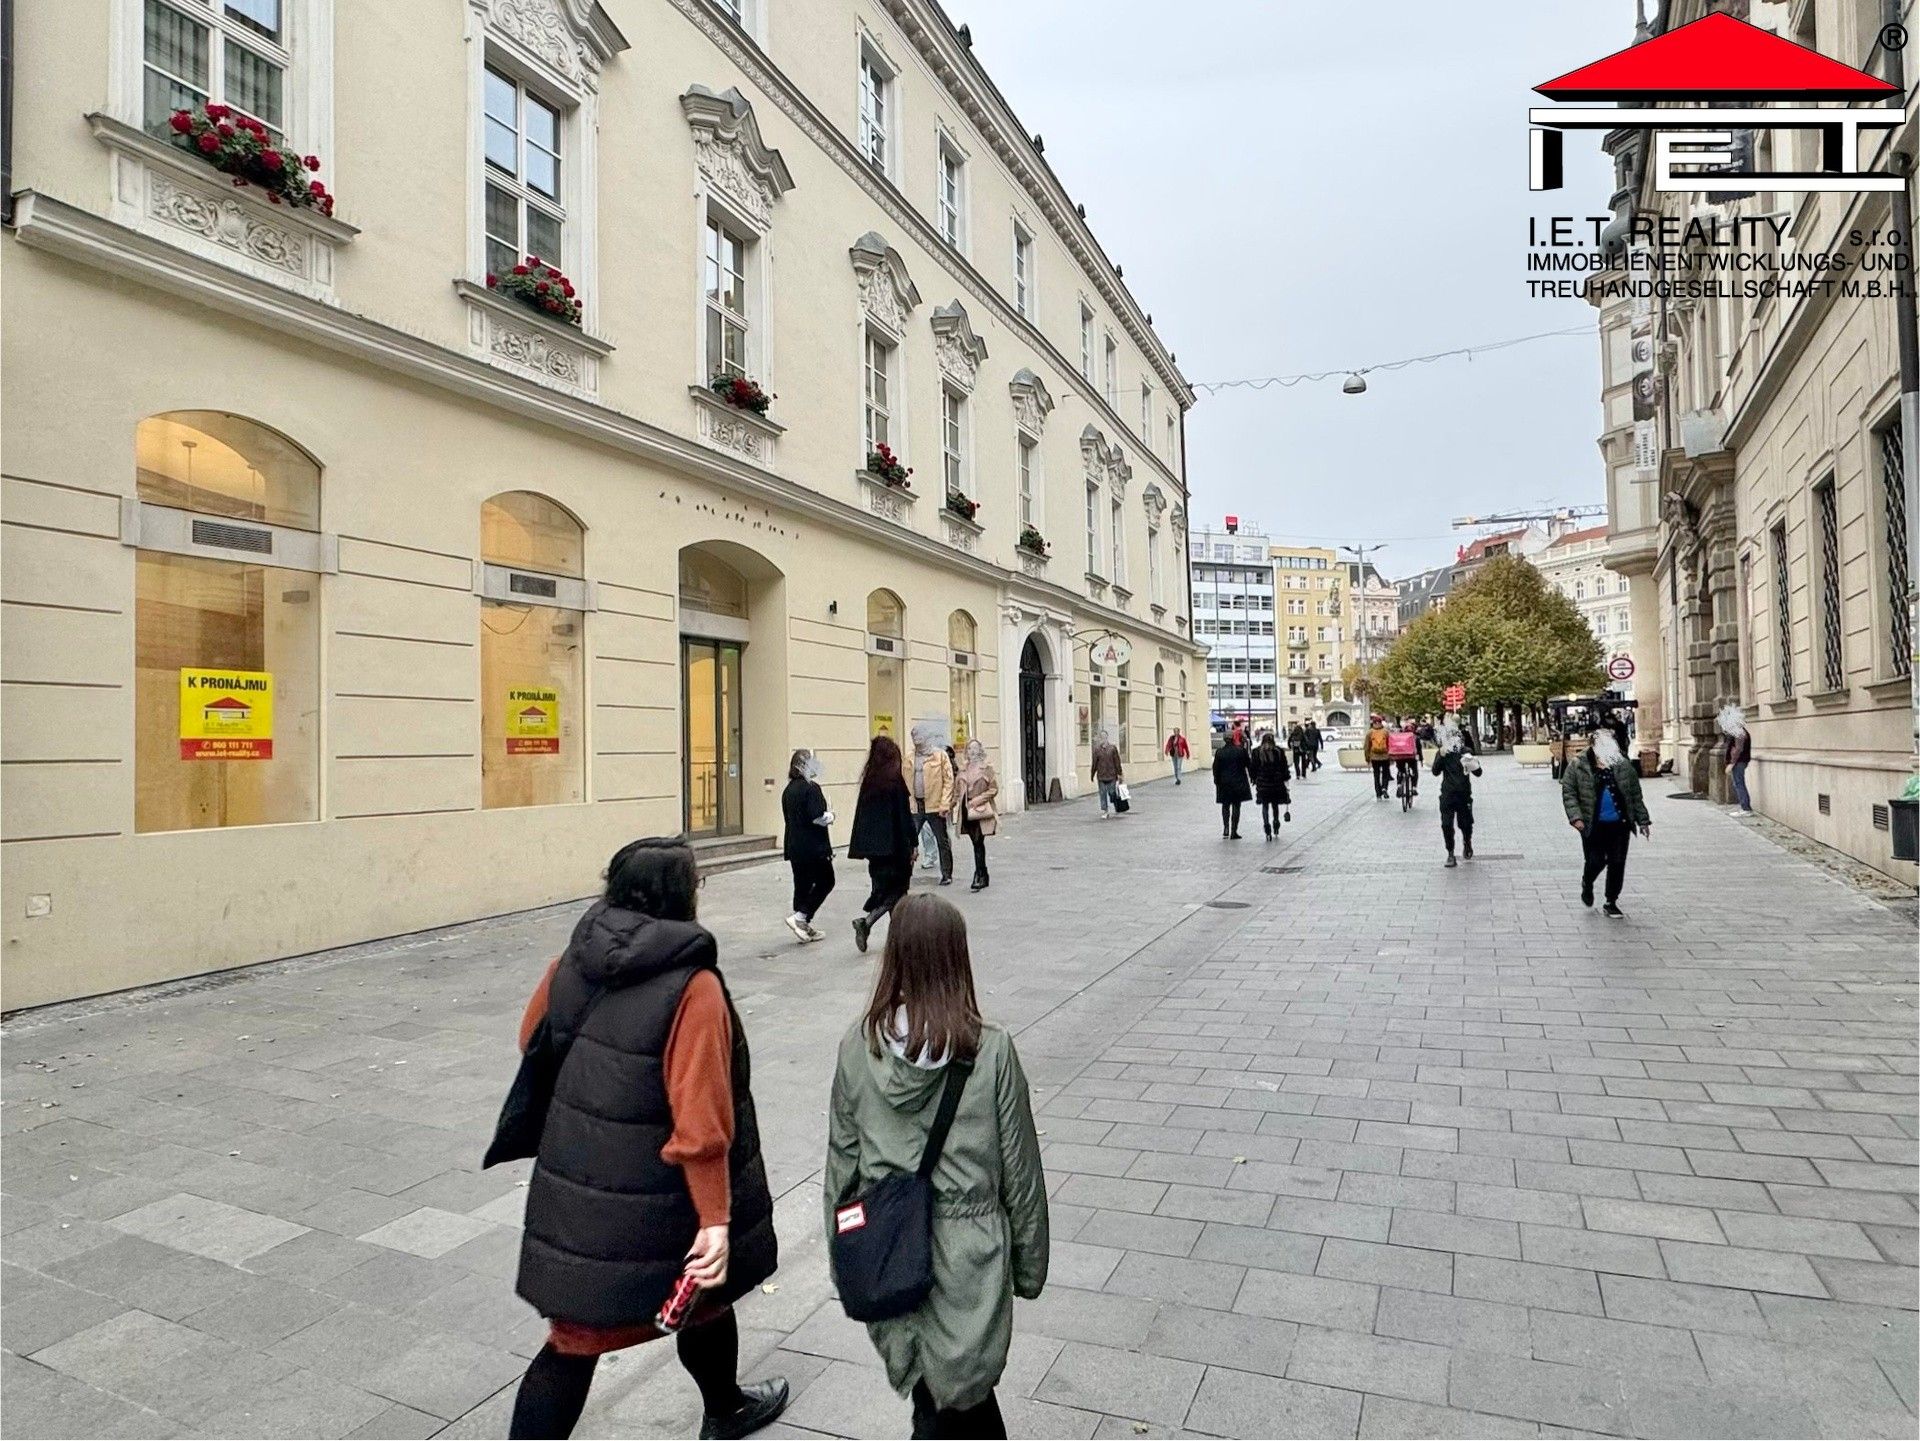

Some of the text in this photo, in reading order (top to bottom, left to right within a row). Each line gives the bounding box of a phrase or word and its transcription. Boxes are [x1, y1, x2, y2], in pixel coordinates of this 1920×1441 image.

[188, 675, 267, 691] K PRONÁJMU
[509, 690, 556, 702] K PRONÁJMU
